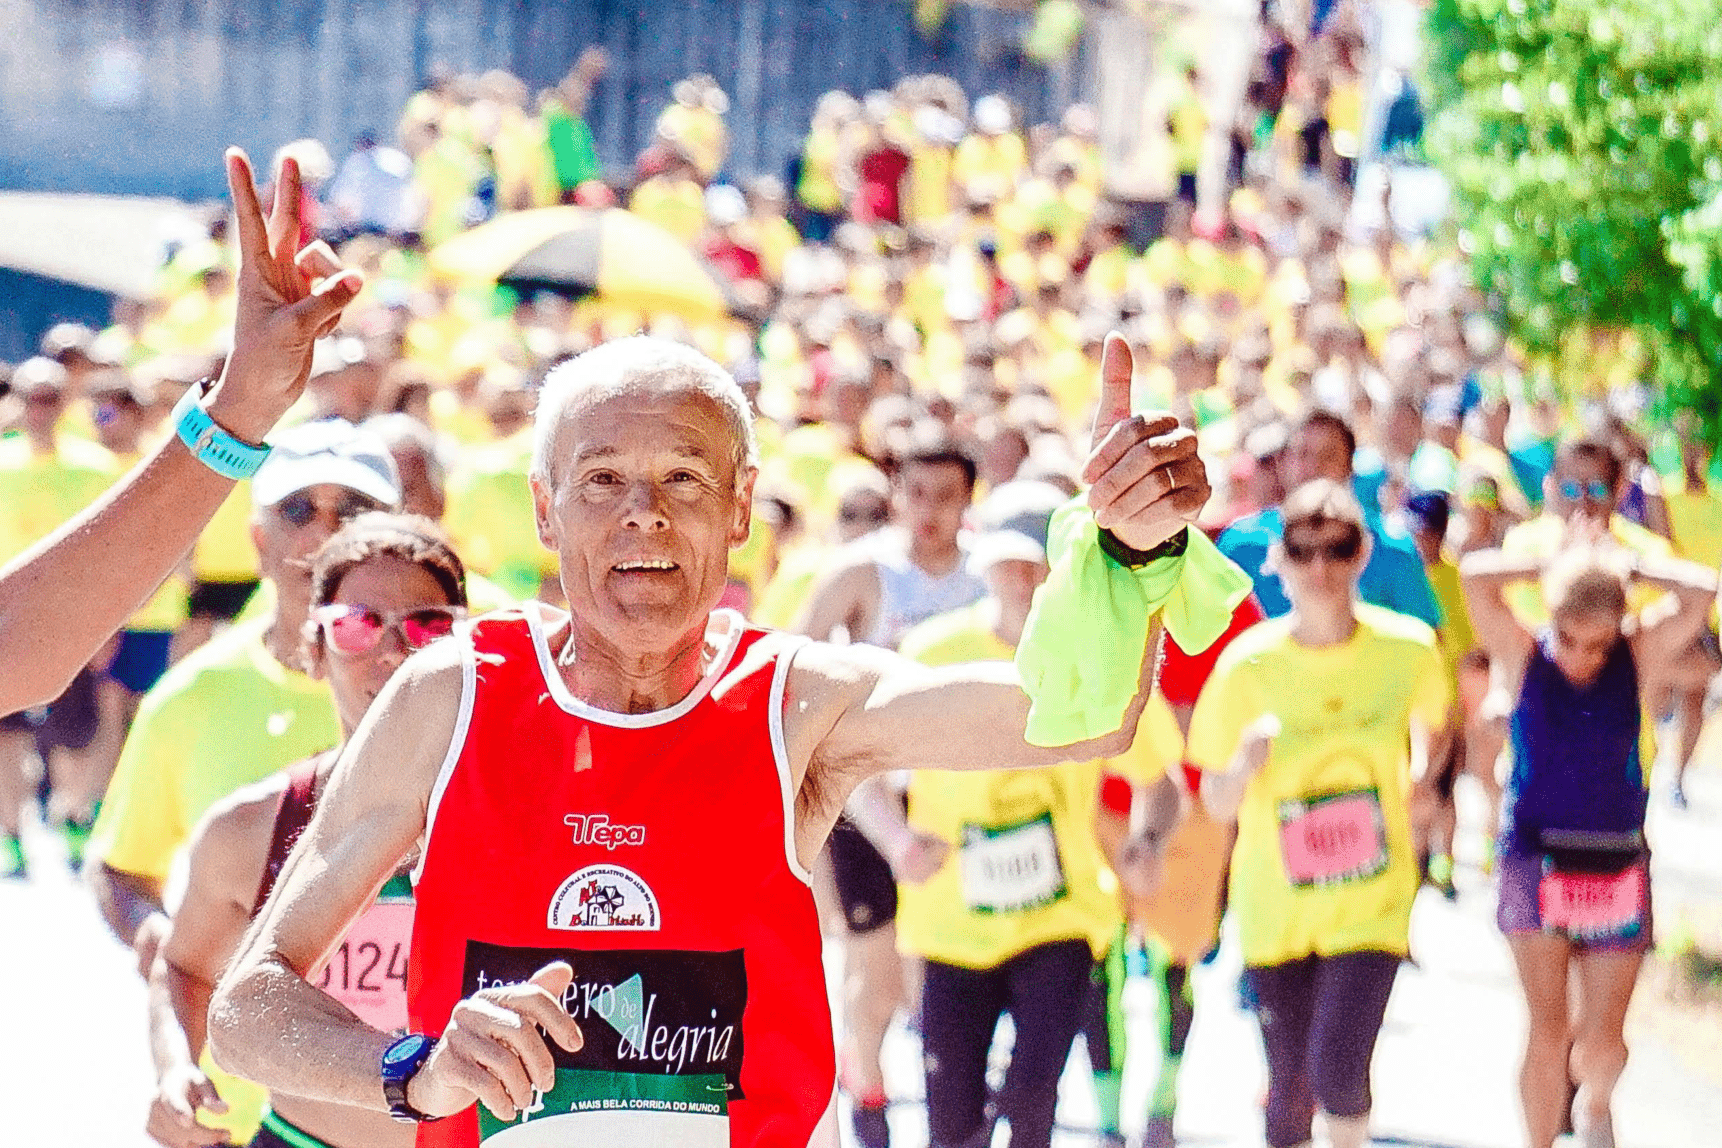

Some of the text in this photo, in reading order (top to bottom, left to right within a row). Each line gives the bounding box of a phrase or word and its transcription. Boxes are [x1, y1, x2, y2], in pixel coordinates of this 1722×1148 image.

[620, 996, 637, 1019] de
[617, 993, 734, 1075] alegria
[570, 1099, 721, 1113] A MAIS BELA CORRIDA DO MUNDO
